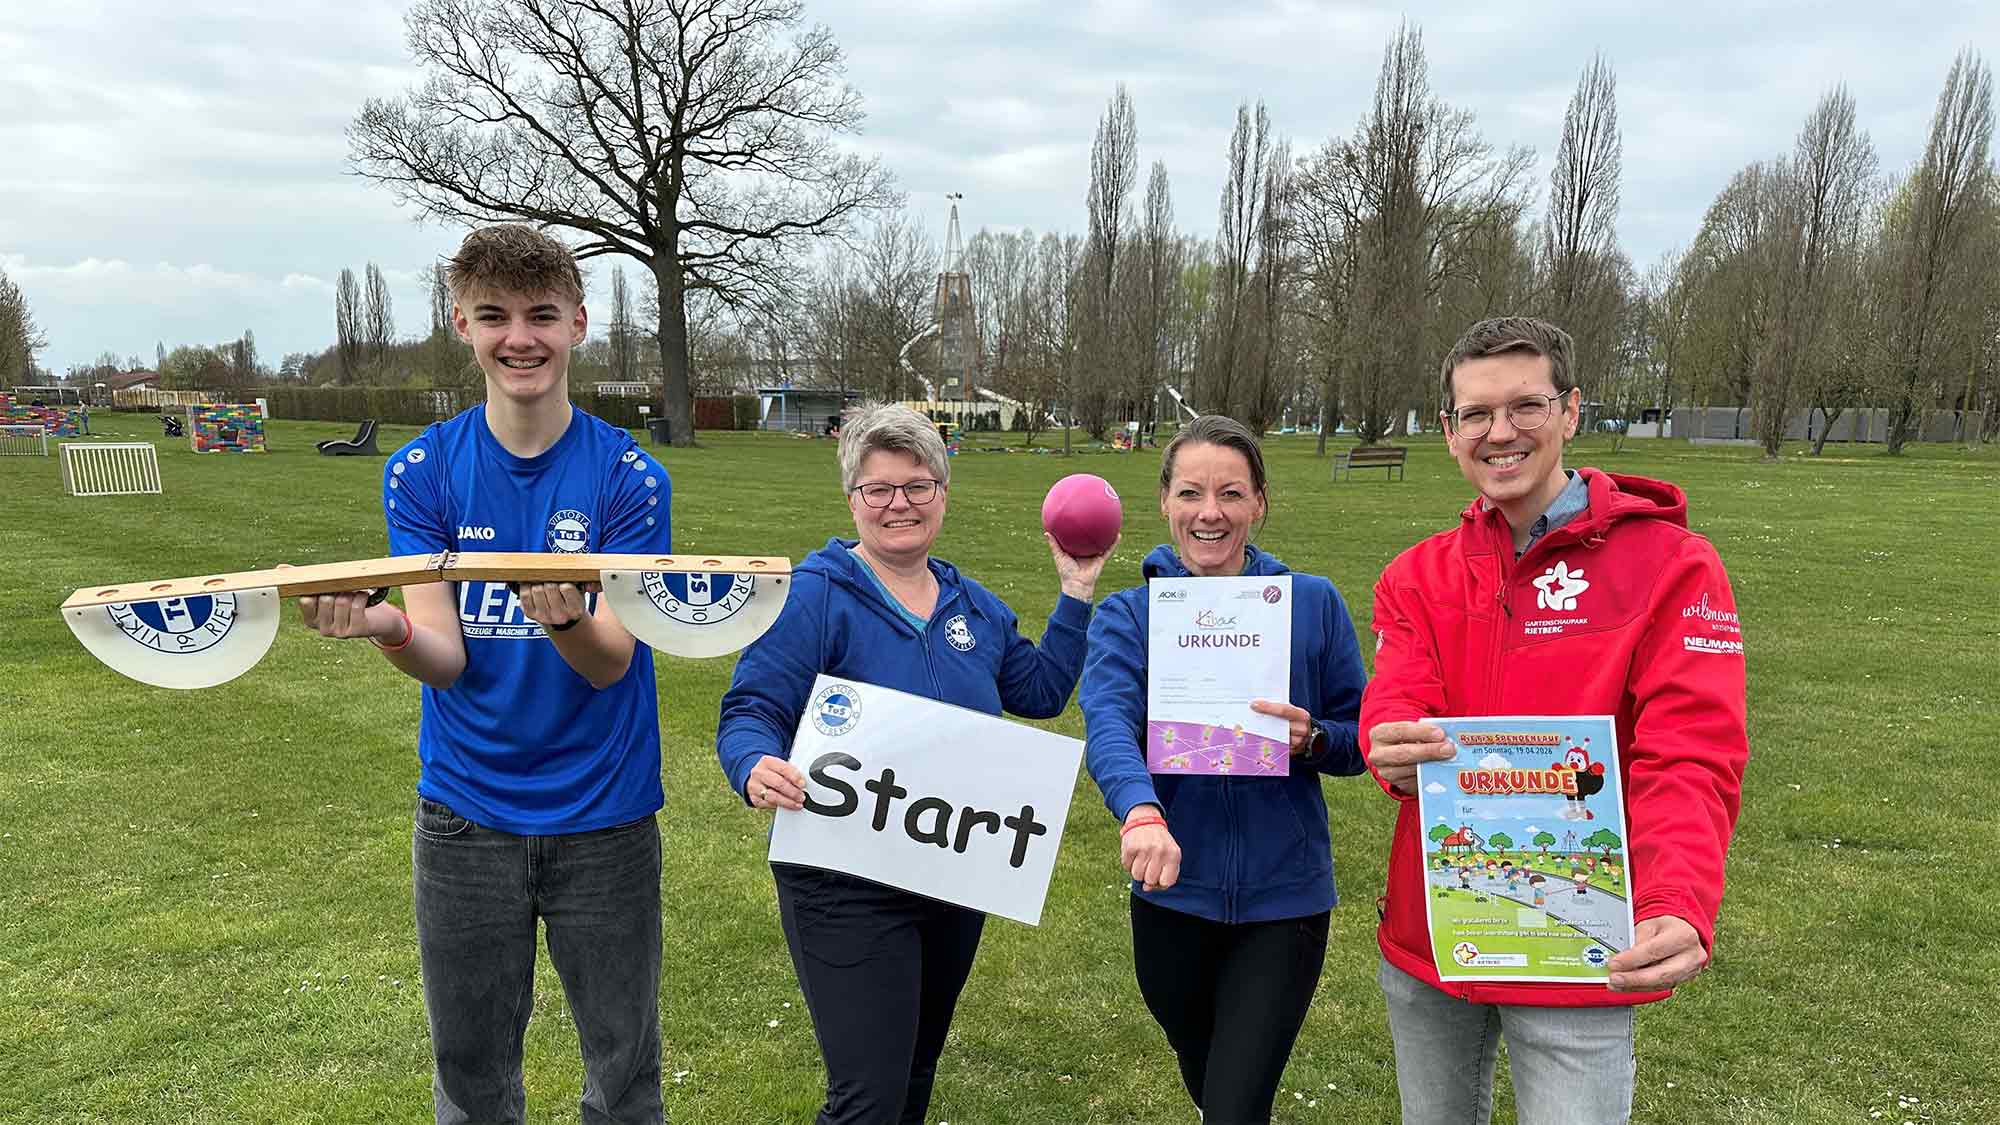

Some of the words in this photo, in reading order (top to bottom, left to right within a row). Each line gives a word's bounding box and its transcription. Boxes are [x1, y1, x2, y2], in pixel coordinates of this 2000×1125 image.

[550, 511, 590, 528] VIKTORIA
[457, 526, 496, 540] JAKO
[560, 530, 580, 540] TuS
[1159, 591, 1177, 599] AOK
[692, 608, 707, 622] 10
[1524, 618, 1588, 627] GARTENSCHAUPARK
[1524, 626, 1563, 635] RIETBERG
[1178, 634, 1261, 648] URKUNDE
[828, 705, 846, 716] TuS
[1459, 770, 1577, 794] URKUNDE
[804, 752, 1047, 868] Start
